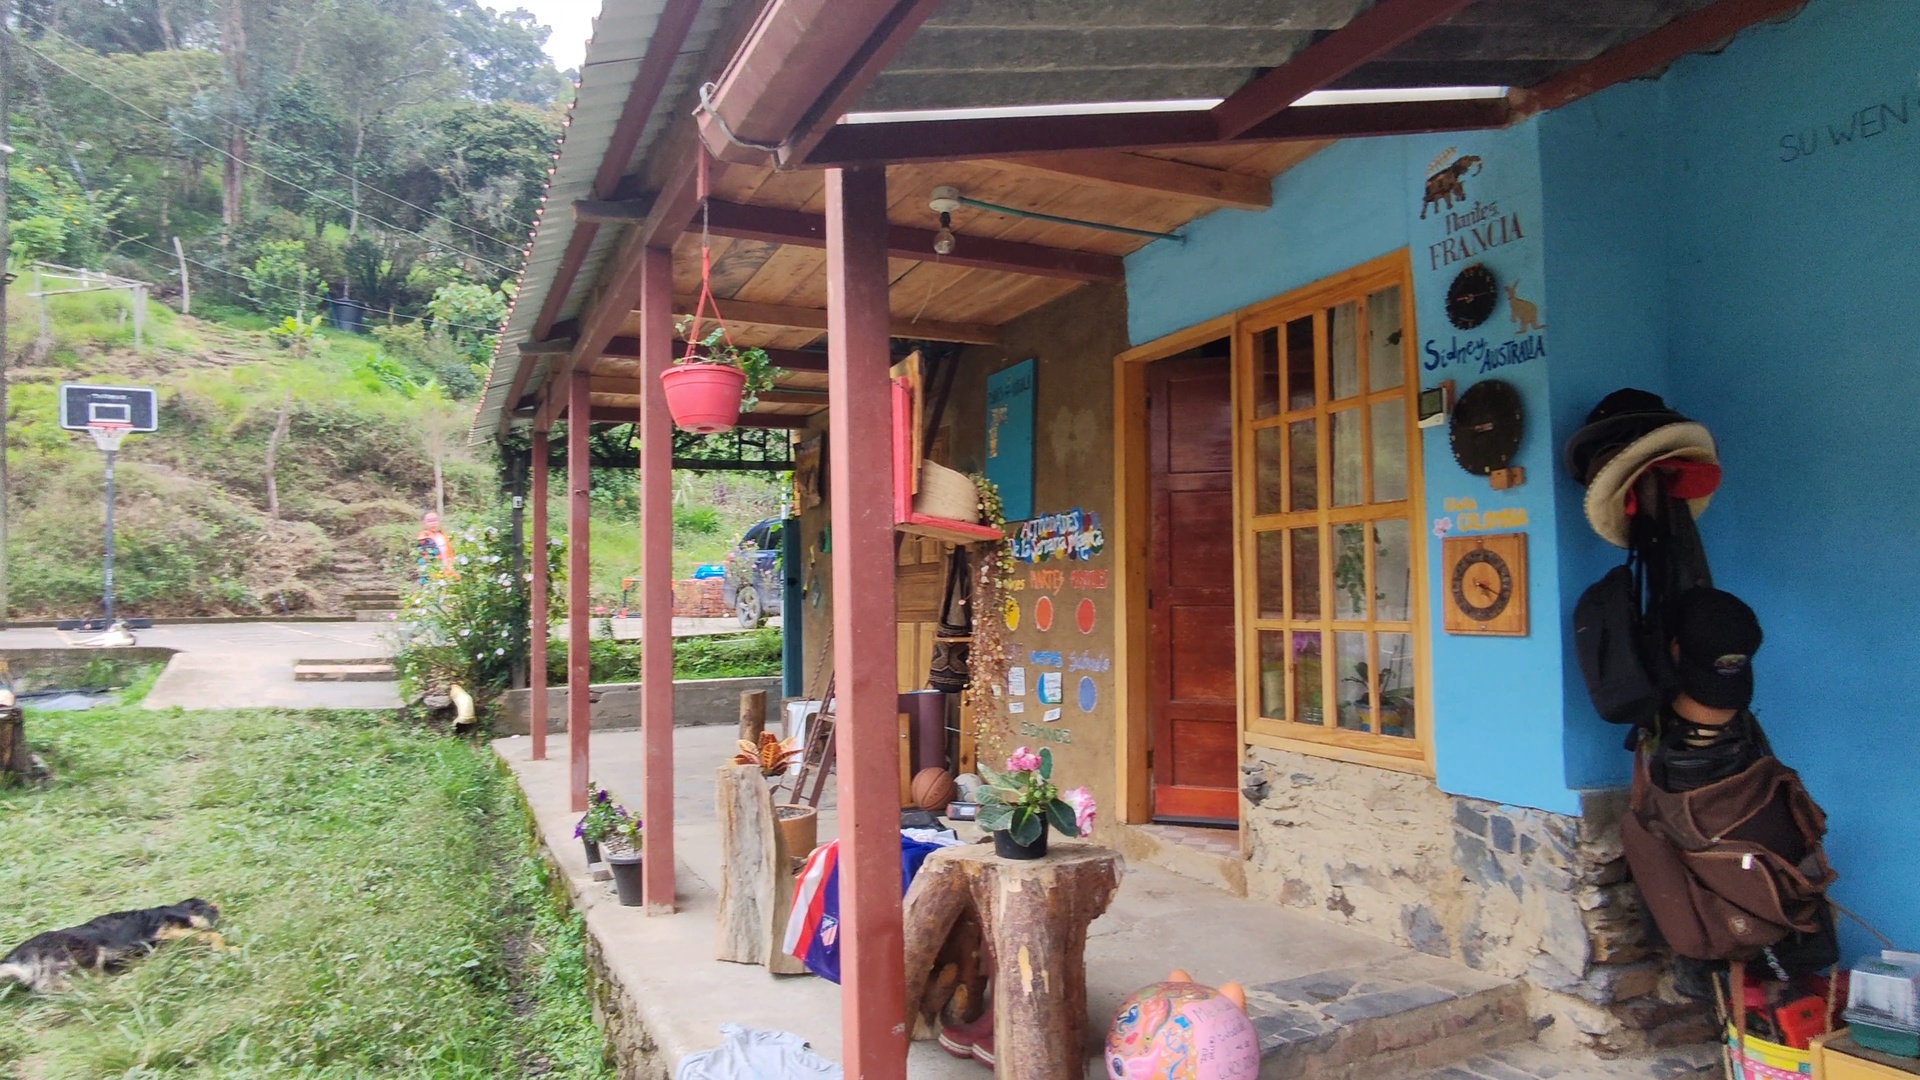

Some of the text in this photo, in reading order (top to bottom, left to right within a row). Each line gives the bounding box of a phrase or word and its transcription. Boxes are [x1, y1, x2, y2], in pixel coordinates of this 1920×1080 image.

[1429, 212, 1525, 271] FRANCIA
[1424, 335, 1546, 374] Sidney AUSTRALIA
